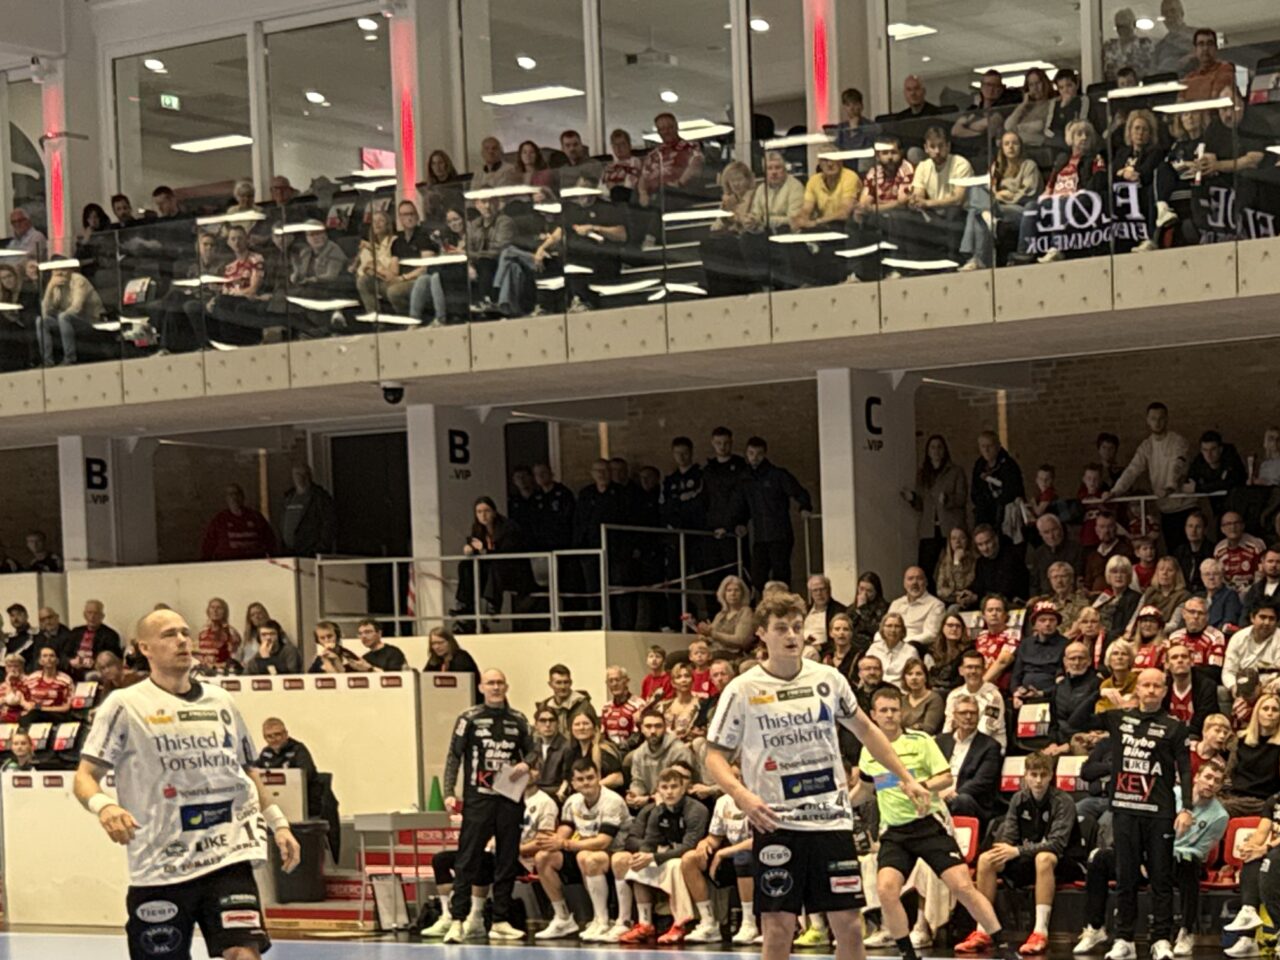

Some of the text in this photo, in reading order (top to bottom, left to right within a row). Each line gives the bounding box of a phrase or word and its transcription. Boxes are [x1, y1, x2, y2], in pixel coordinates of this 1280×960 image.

[865, 396, 883, 435] C
[448, 429, 470, 464] B
[86, 457, 108, 490] B
[757, 707, 812, 731] Thisted
[154, 731, 218, 752] Thisted
[1122, 733, 1156, 749] Thybo
[1123, 746, 1151, 759] Biler
[1116, 772, 1157, 802] KEY
